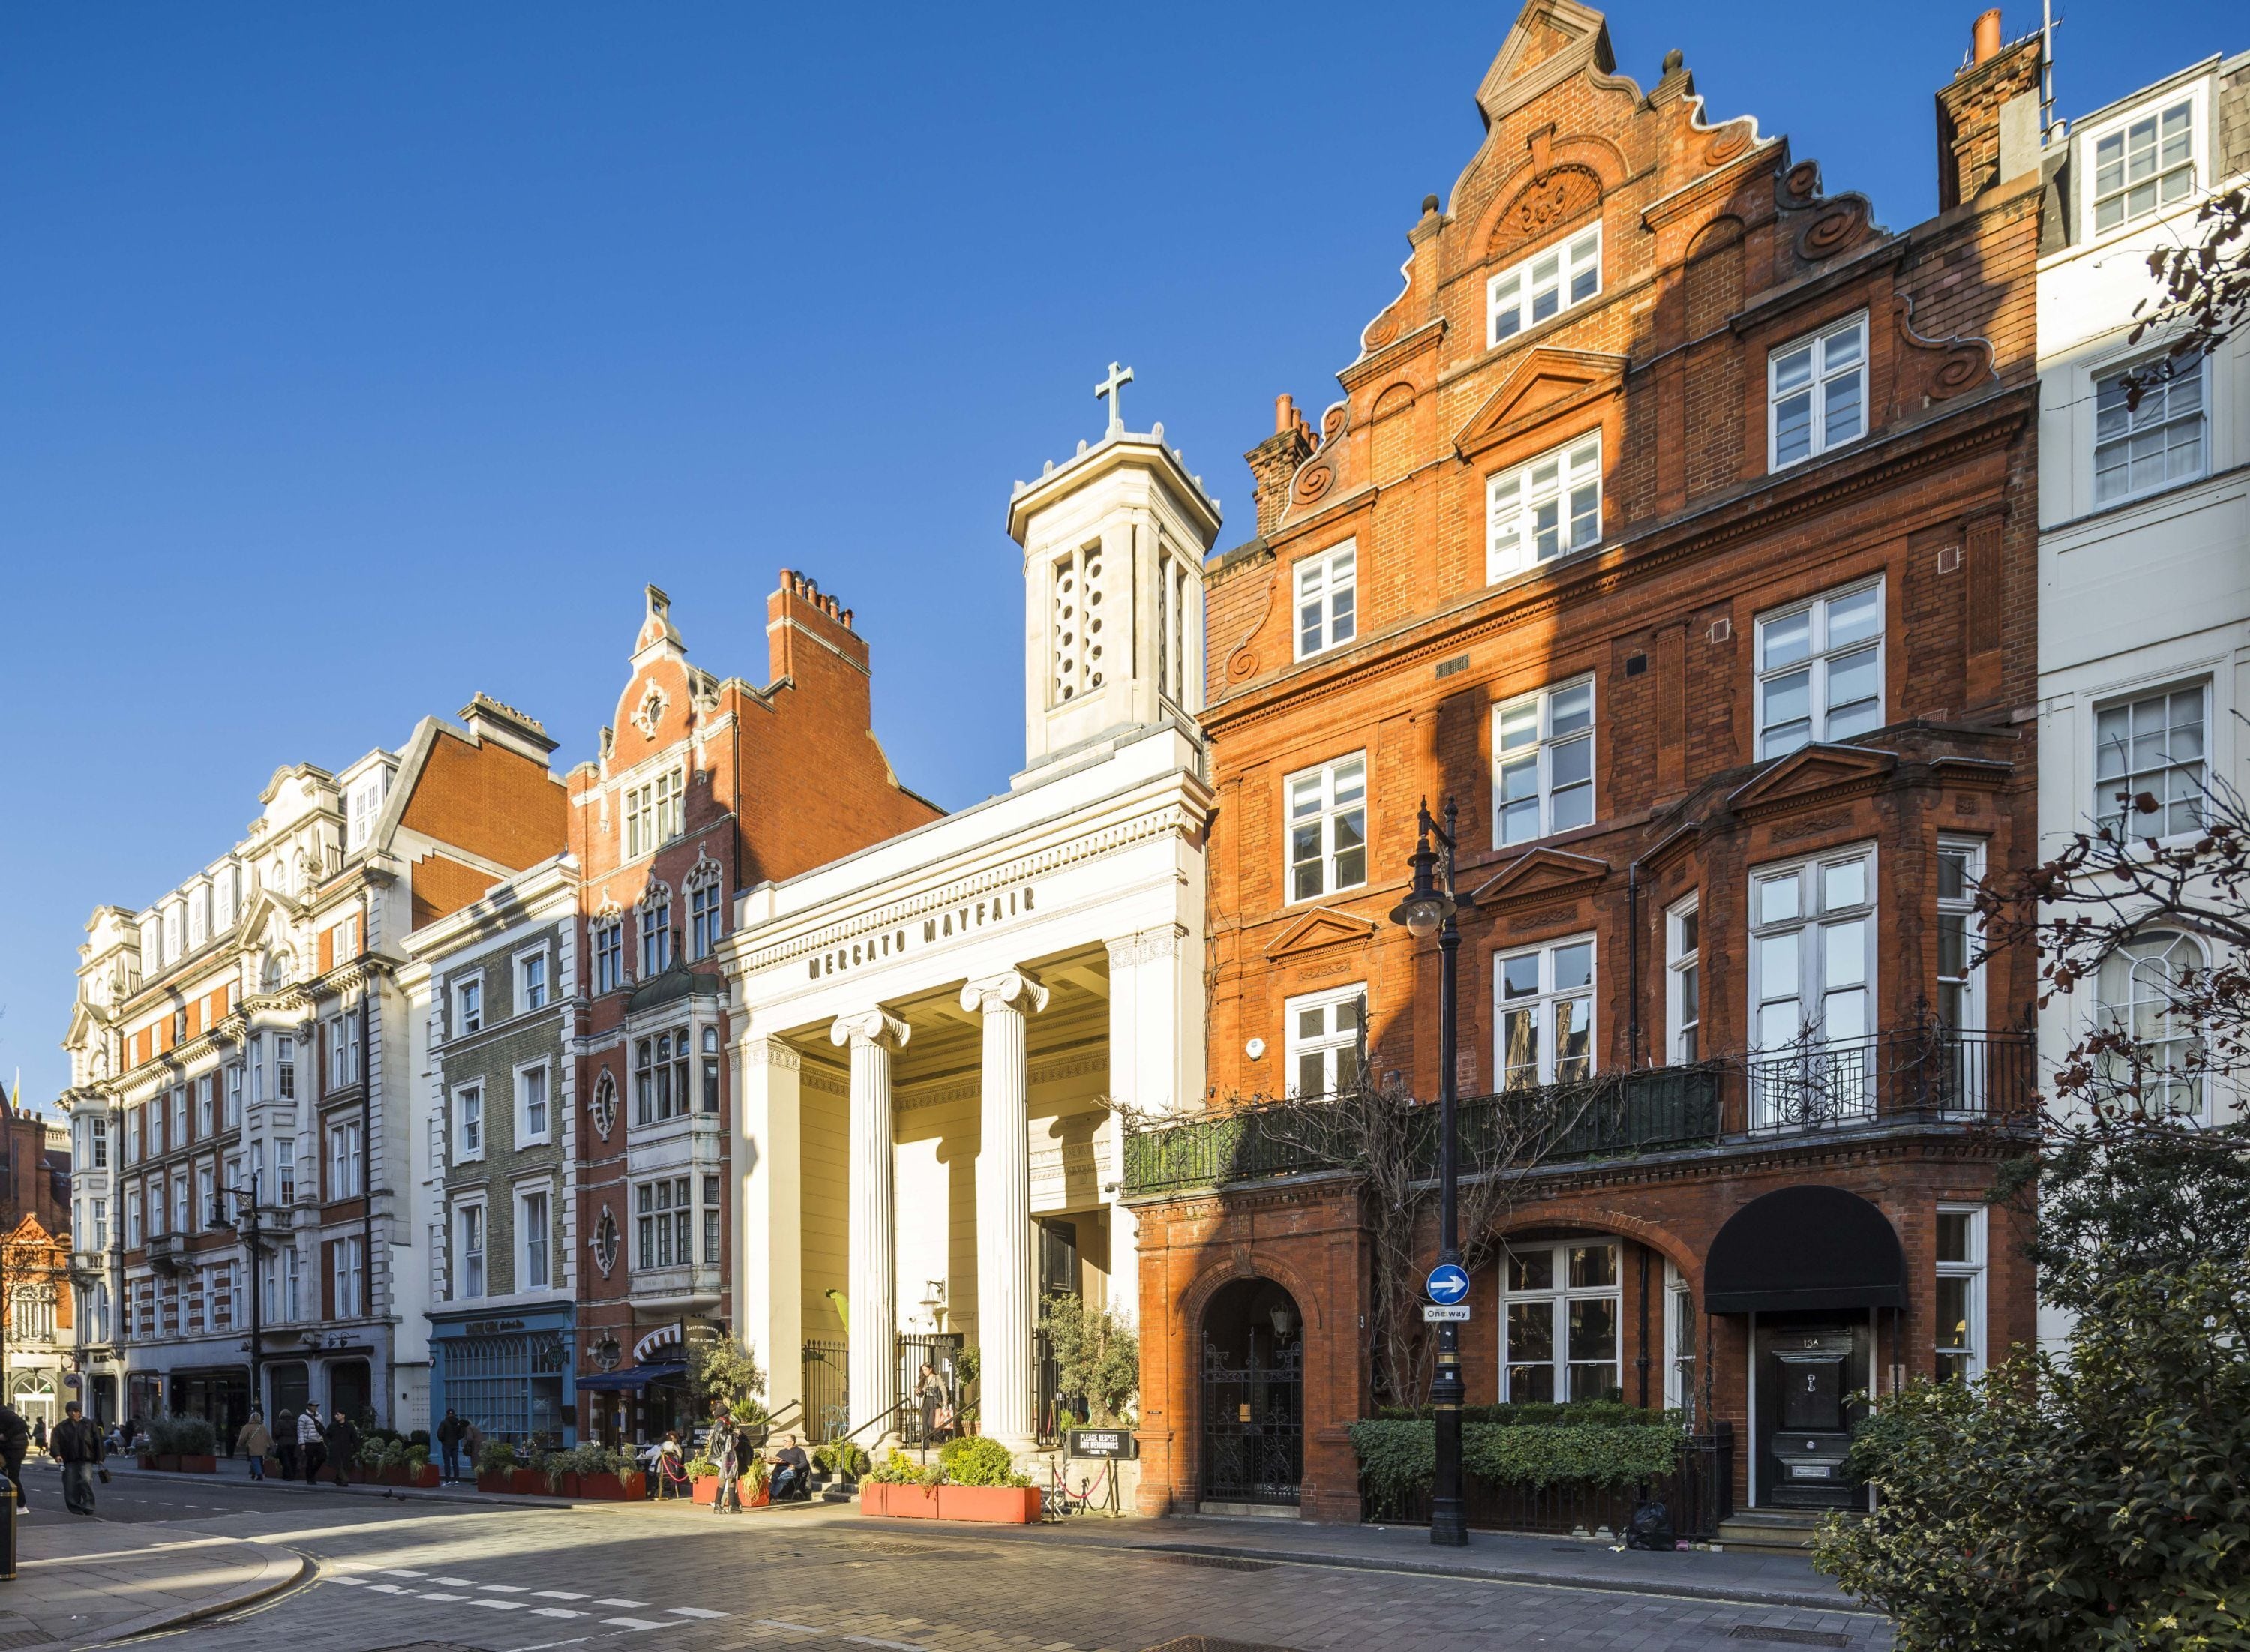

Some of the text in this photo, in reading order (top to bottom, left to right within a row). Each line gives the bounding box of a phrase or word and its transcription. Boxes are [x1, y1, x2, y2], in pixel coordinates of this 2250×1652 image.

[809, 886, 1035, 980] MERCATO MAYFAIR
[1448, 1310, 1466, 1318] way
[1080, 1433, 1098, 1441] PLEASE
[1090, 1441, 1119, 1450] NEIGHBOURS
